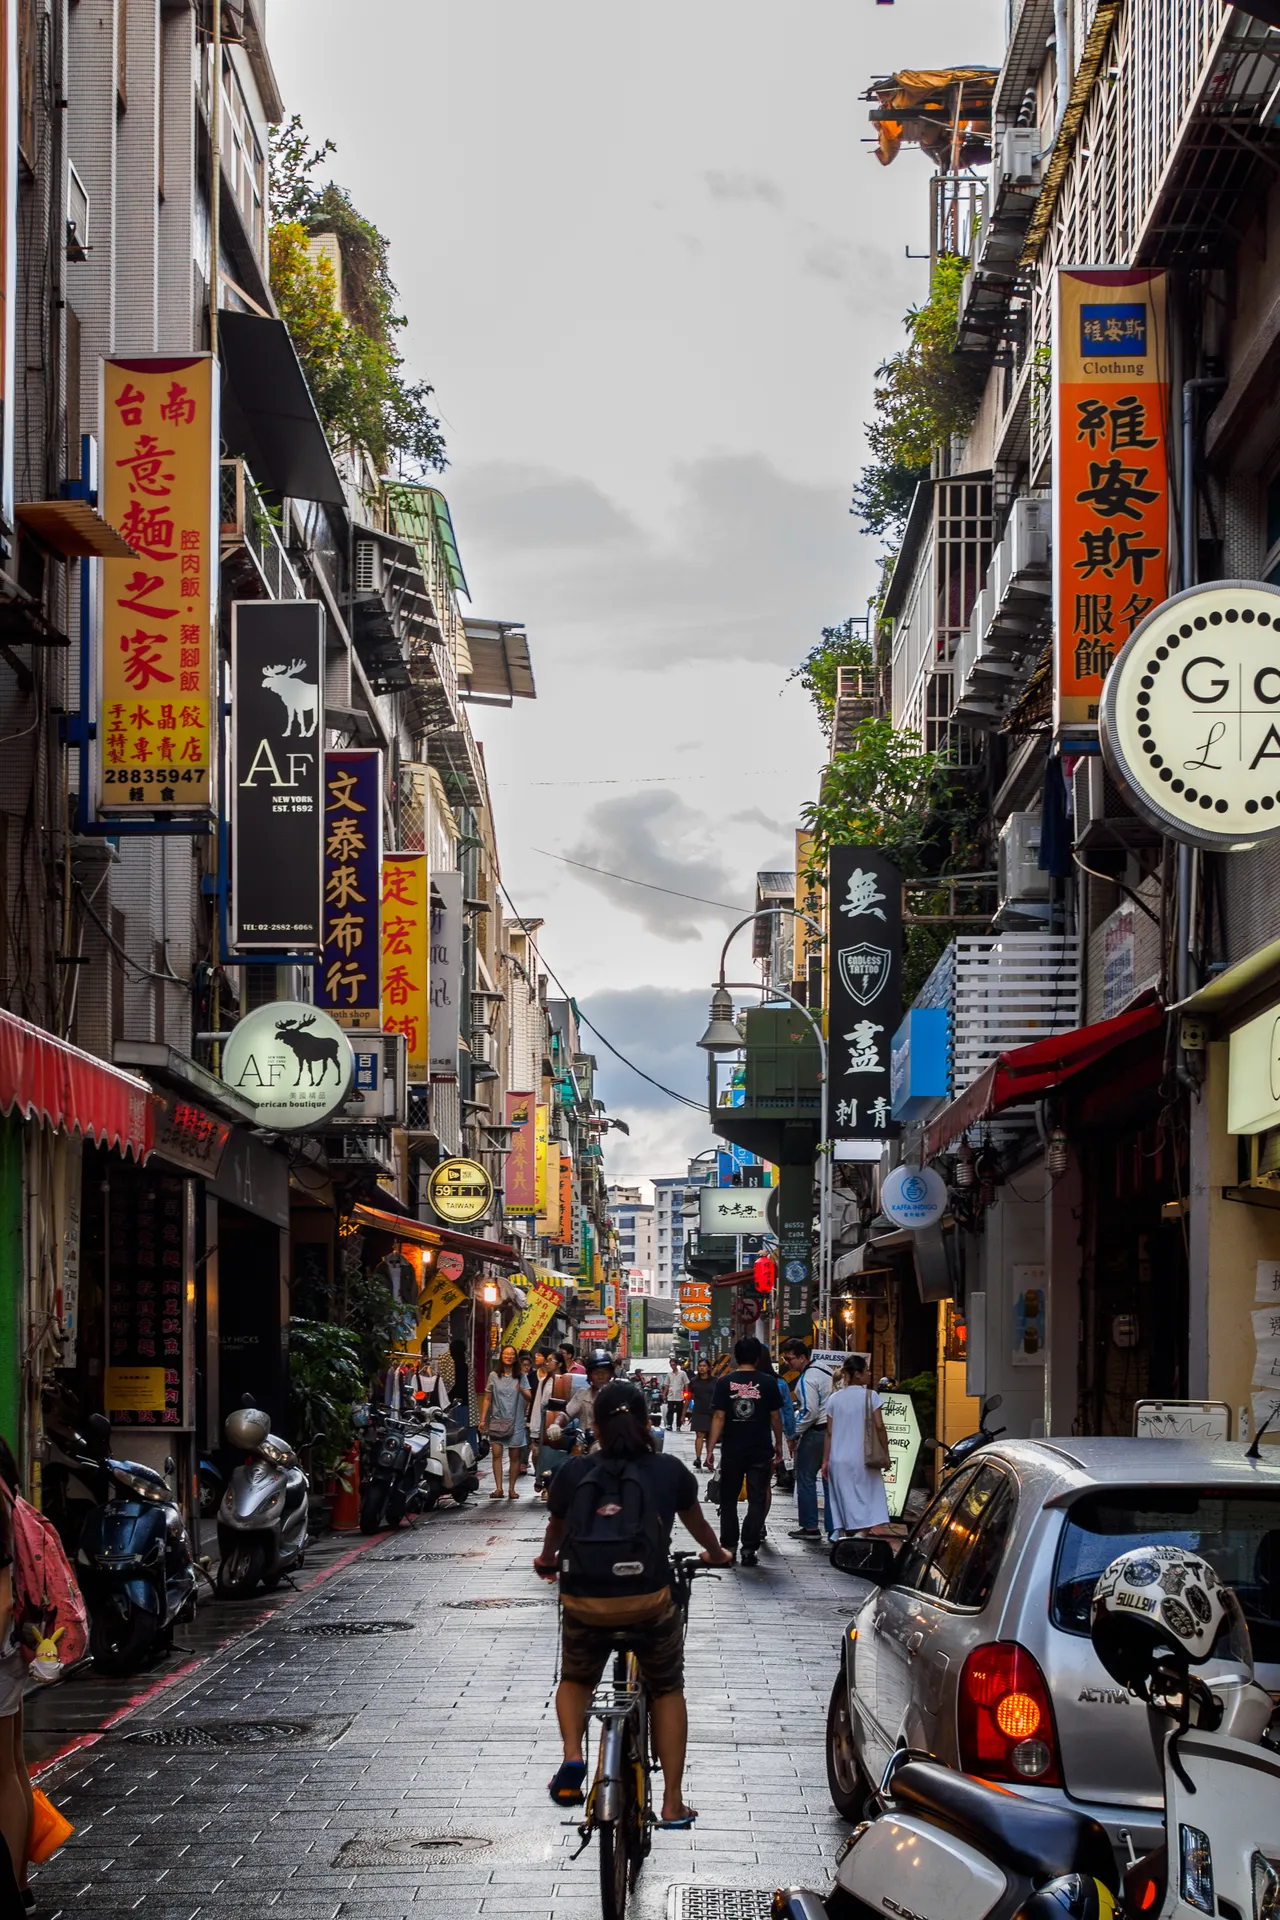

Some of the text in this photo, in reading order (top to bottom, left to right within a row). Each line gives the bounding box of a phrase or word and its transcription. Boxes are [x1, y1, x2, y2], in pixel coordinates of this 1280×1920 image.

[1083, 318, 1145, 343] 維安斯
[1083, 361, 1144, 377] Clothing
[114, 381, 197, 427] 台南
[1071, 395, 1162, 587] 維安斯
[114, 434, 181, 691] 意麵之家
[129, 704, 205, 731] 水晶餃
[129, 736, 203, 763] 專賣店
[104, 768, 206, 785] 28835947
[272, 805, 314, 813] EST. 1892
[324, 769, 368, 1005] 文泰來布行
[847, 955, 882, 965] ENDLESS
[847, 964, 880, 974] TATTOO
[349, 1009, 371, 1020] shop
[357, 1054, 373, 1084] 百峰
[255, 1100, 327, 1109] erican boutique
[834, 1096, 892, 1129] 刺青
[435, 1185, 487, 1196] 59FIFTY
[891, 1203, 938, 1211] KAFFA INDIGO
[1077, 1685, 1131, 1705] ACTIVA
